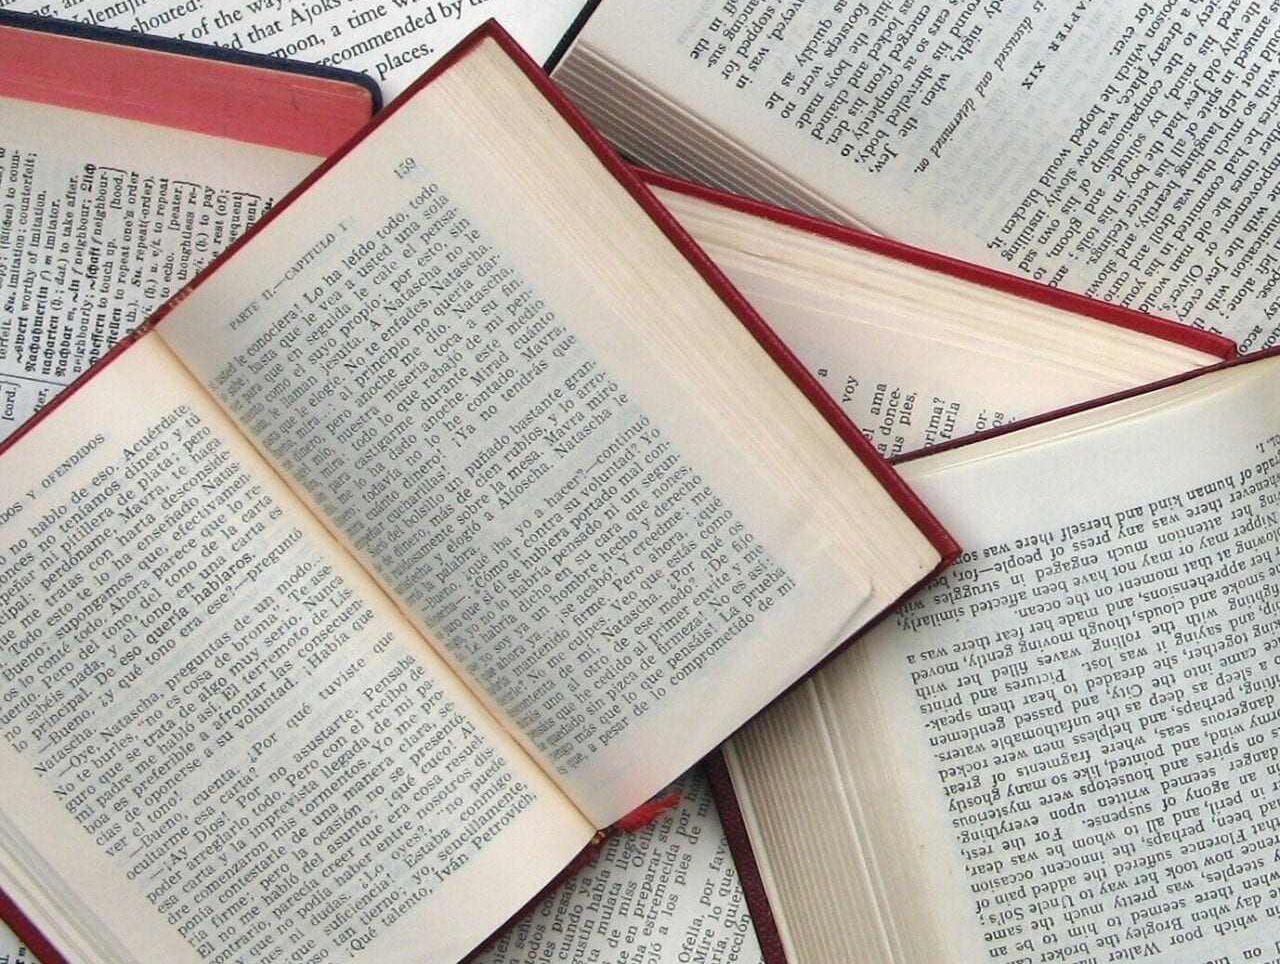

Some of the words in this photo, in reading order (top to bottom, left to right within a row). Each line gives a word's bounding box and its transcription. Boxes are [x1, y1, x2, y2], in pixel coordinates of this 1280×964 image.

[1032, 0, 1044, 13] is
[190, 15, 210, 39] of
[213, 9, 244, 30] the
[993, 15, 1033, 72] discussed
[747, 47, 770, 73] was
[735, 73, 750, 89] in
[974, 70, 993, 98] and
[1020, 60, 1047, 91] XIX
[929, 97, 976, 159] determined
[392, 156, 417, 180] 159
[912, 157, 930, 174] on.
[105, 237, 118, 256] up.
[175, 210, 195, 281] thoughtless
[98, 260, 114, 294] touch
[227, 300, 261, 331] PARTE
[336, 221, 348, 232] I
[96, 296, 109, 309] to
[841, 374, 859, 403] voy
[869, 382, 888, 416] ama
[878, 386, 901, 436] donce-
[1254, 441, 1266, 454] I.
[24, 489, 36, 500] Y
[40, 432, 106, 489] OFENDIDOS
